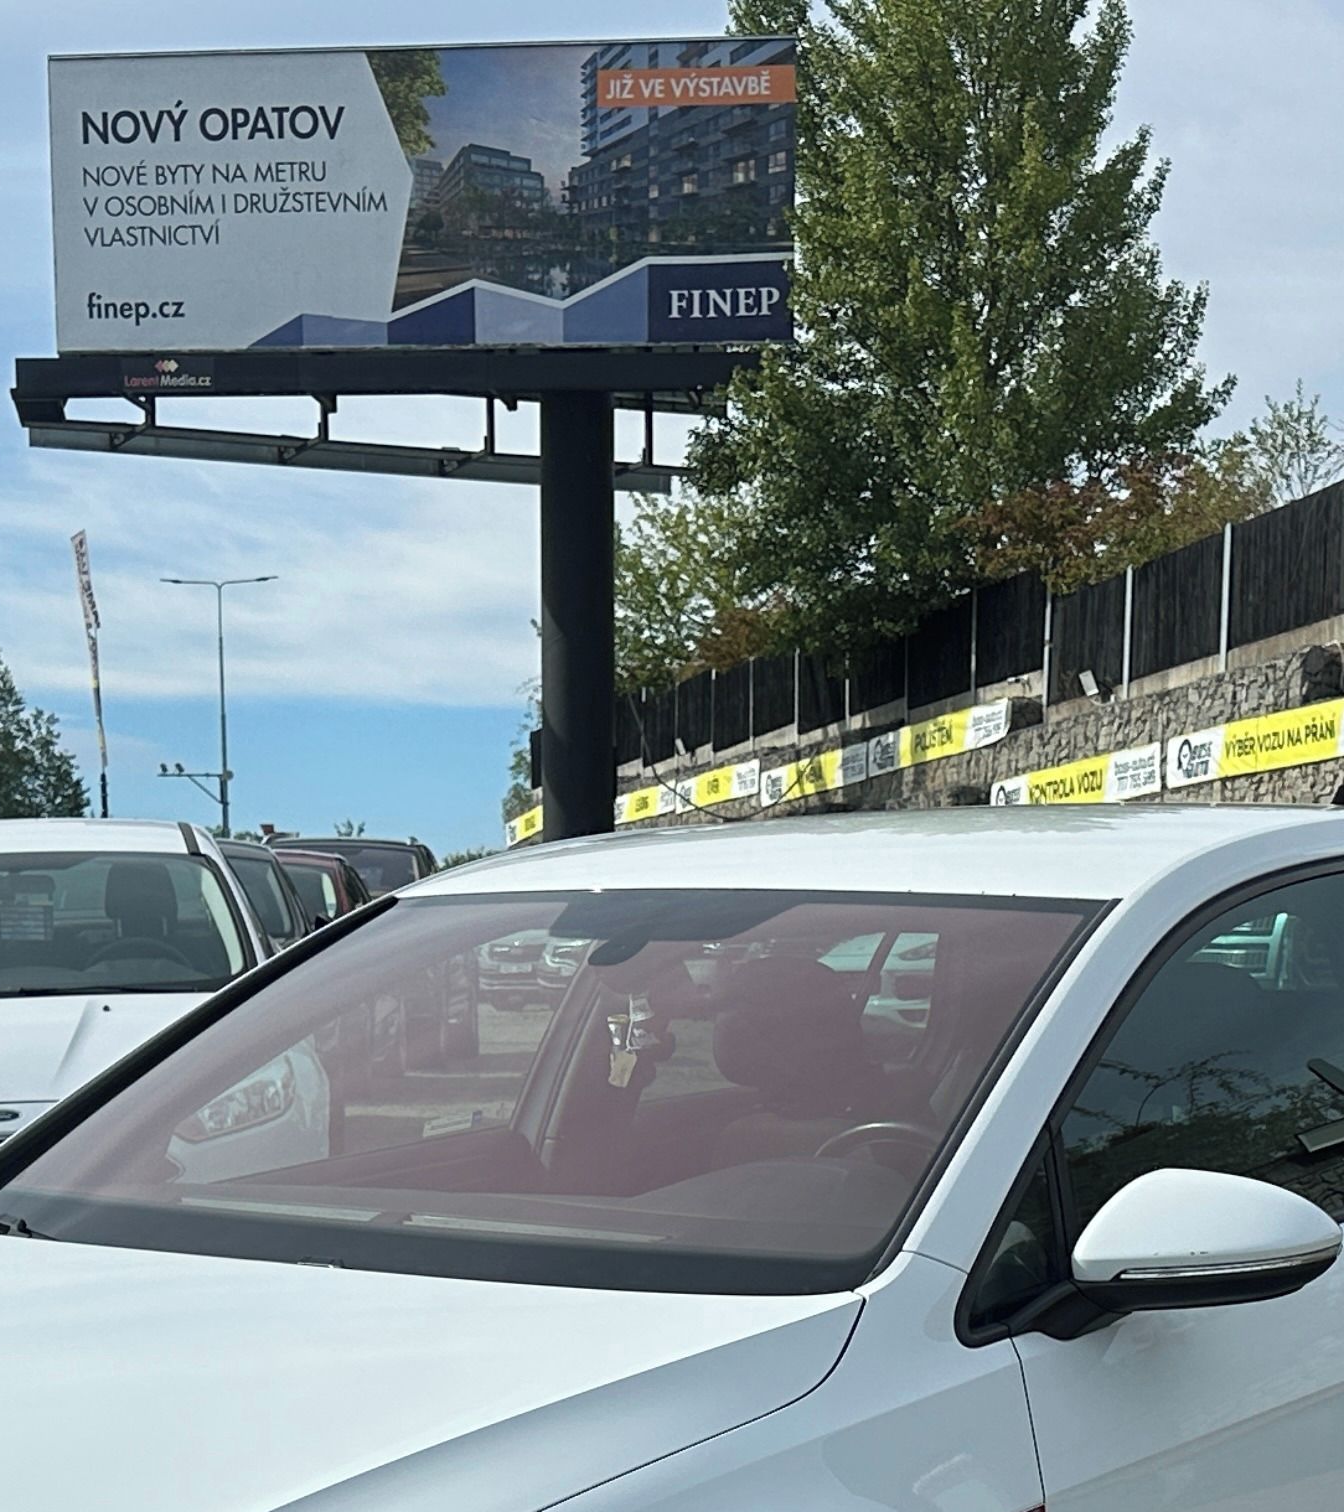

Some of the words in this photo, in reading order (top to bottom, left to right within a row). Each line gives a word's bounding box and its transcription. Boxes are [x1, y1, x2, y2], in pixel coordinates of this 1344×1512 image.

[606, 74, 634, 100] JIŽ
[639, 78, 665, 98] VE
[670, 71, 772, 98] VÝSTAVBĚ
[82, 100, 188, 145] NOVÝ
[199, 105, 345, 142] OPATOV
[82, 160, 147, 187] NOVÉ
[155, 164, 205, 185] BYTY
[212, 162, 248, 184] NA
[254, 161, 326, 183] METRU
[83, 197, 99, 217] V
[105, 189, 214, 217] OSOBNÍM
[221, 194, 227, 214] I
[234, 186, 388, 214] DRUŽSTEVNÍM
[83, 219, 220, 248] VLASTNICTVÍ
[87, 292, 185, 326] finep.cz
[668, 287, 781, 319] FINEP
[1258, 730, 1285, 752] VOZU
[1287, 727, 1303, 745] NA
